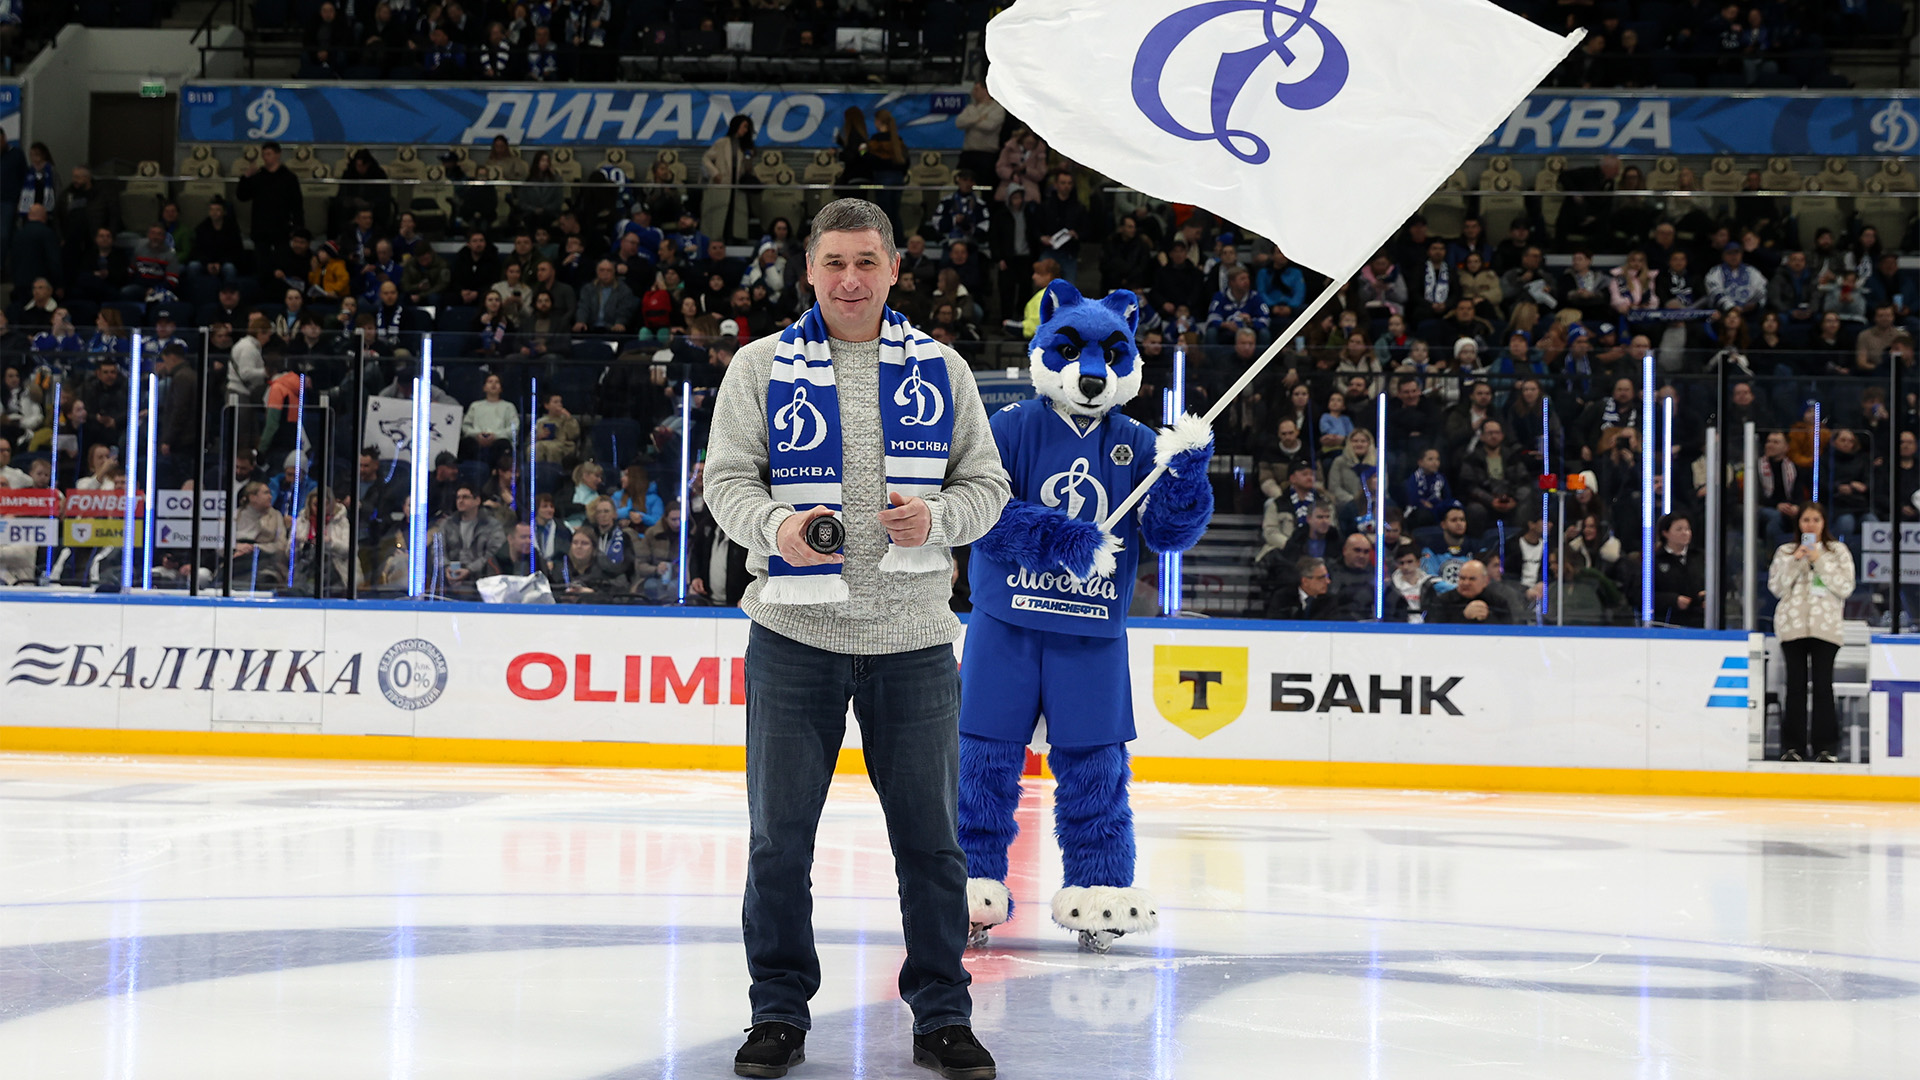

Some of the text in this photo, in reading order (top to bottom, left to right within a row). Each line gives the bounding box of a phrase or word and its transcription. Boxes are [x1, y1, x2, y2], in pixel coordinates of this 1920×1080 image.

[461, 93, 826, 144] ДИНАМО
[1481, 99, 1671, 149] КВА
[890, 440, 949, 452] МОСКВА
[772, 466, 837, 478] МОСКВА
[67, 495, 143, 510] FONBET
[166, 497, 227, 511] соаз
[10, 525, 47, 542] ВТБ
[95, 528, 128, 538] БАН
[1027, 598, 1107, 617] ТРАНСНЕФТЬ
[61, 644, 363, 695] БАЛТИКА
[1270, 672, 1464, 716] БАНК
